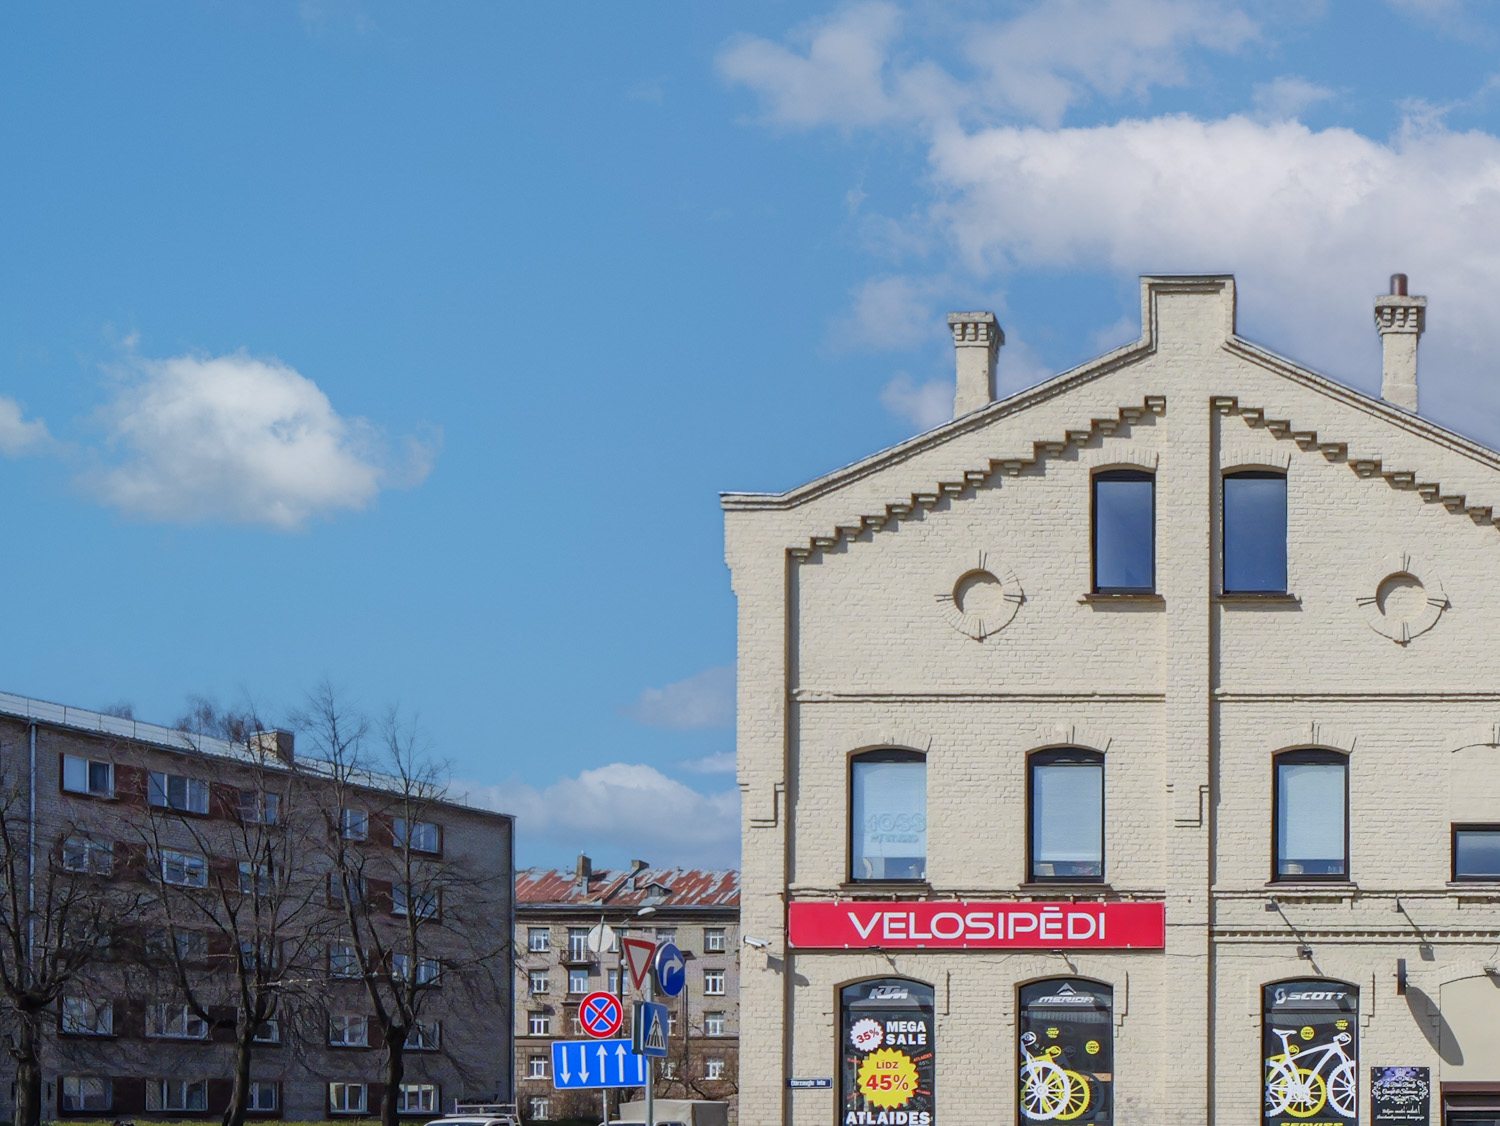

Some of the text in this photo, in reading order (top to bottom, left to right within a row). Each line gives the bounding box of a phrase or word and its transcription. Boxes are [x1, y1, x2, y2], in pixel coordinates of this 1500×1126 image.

[848, 906, 1106, 940] VELOSIPĒDI
[868, 985, 909, 999] KTM
[1287, 992, 1347, 1000] SCOTT
[886, 1021, 926, 1032] MEGA
[856, 1027, 879, 1043] 35%
[885, 1034, 927, 1045] SALE
[876, 1060, 899, 1069] LĪDZ
[866, 1074, 909, 1091] 45%
[846, 1111, 931, 1125] ATLAIDES
